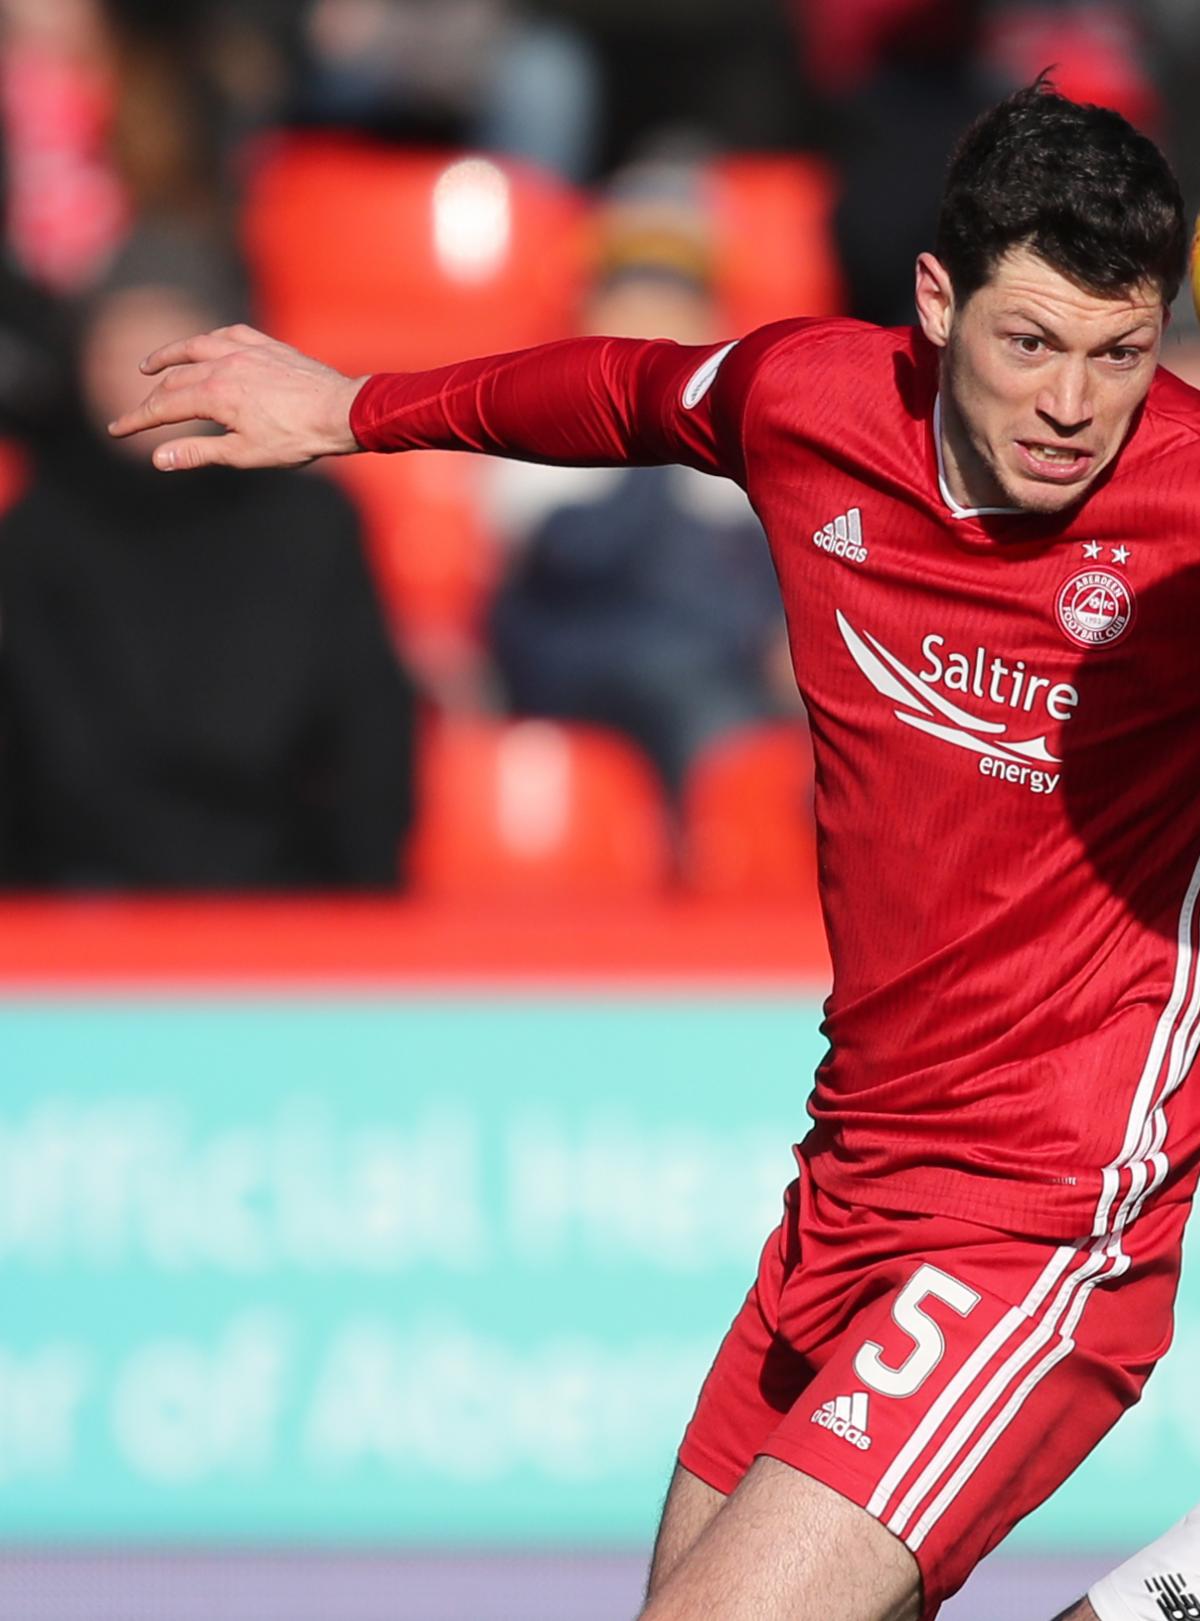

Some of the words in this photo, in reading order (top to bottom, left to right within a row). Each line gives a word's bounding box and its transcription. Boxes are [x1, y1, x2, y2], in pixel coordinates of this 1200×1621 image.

[813, 531, 868, 563] adidas
[1075, 575, 1123, 598] ABERDEEN
[1063, 606, 1105, 641] FOOTBALL
[1105, 615, 1126, 638] CLUB
[918, 634, 1079, 721] Saltire
[979, 755, 1060, 794] energy
[853, 1263, 982, 1398] 5
[811, 1408, 872, 1451] adidas
